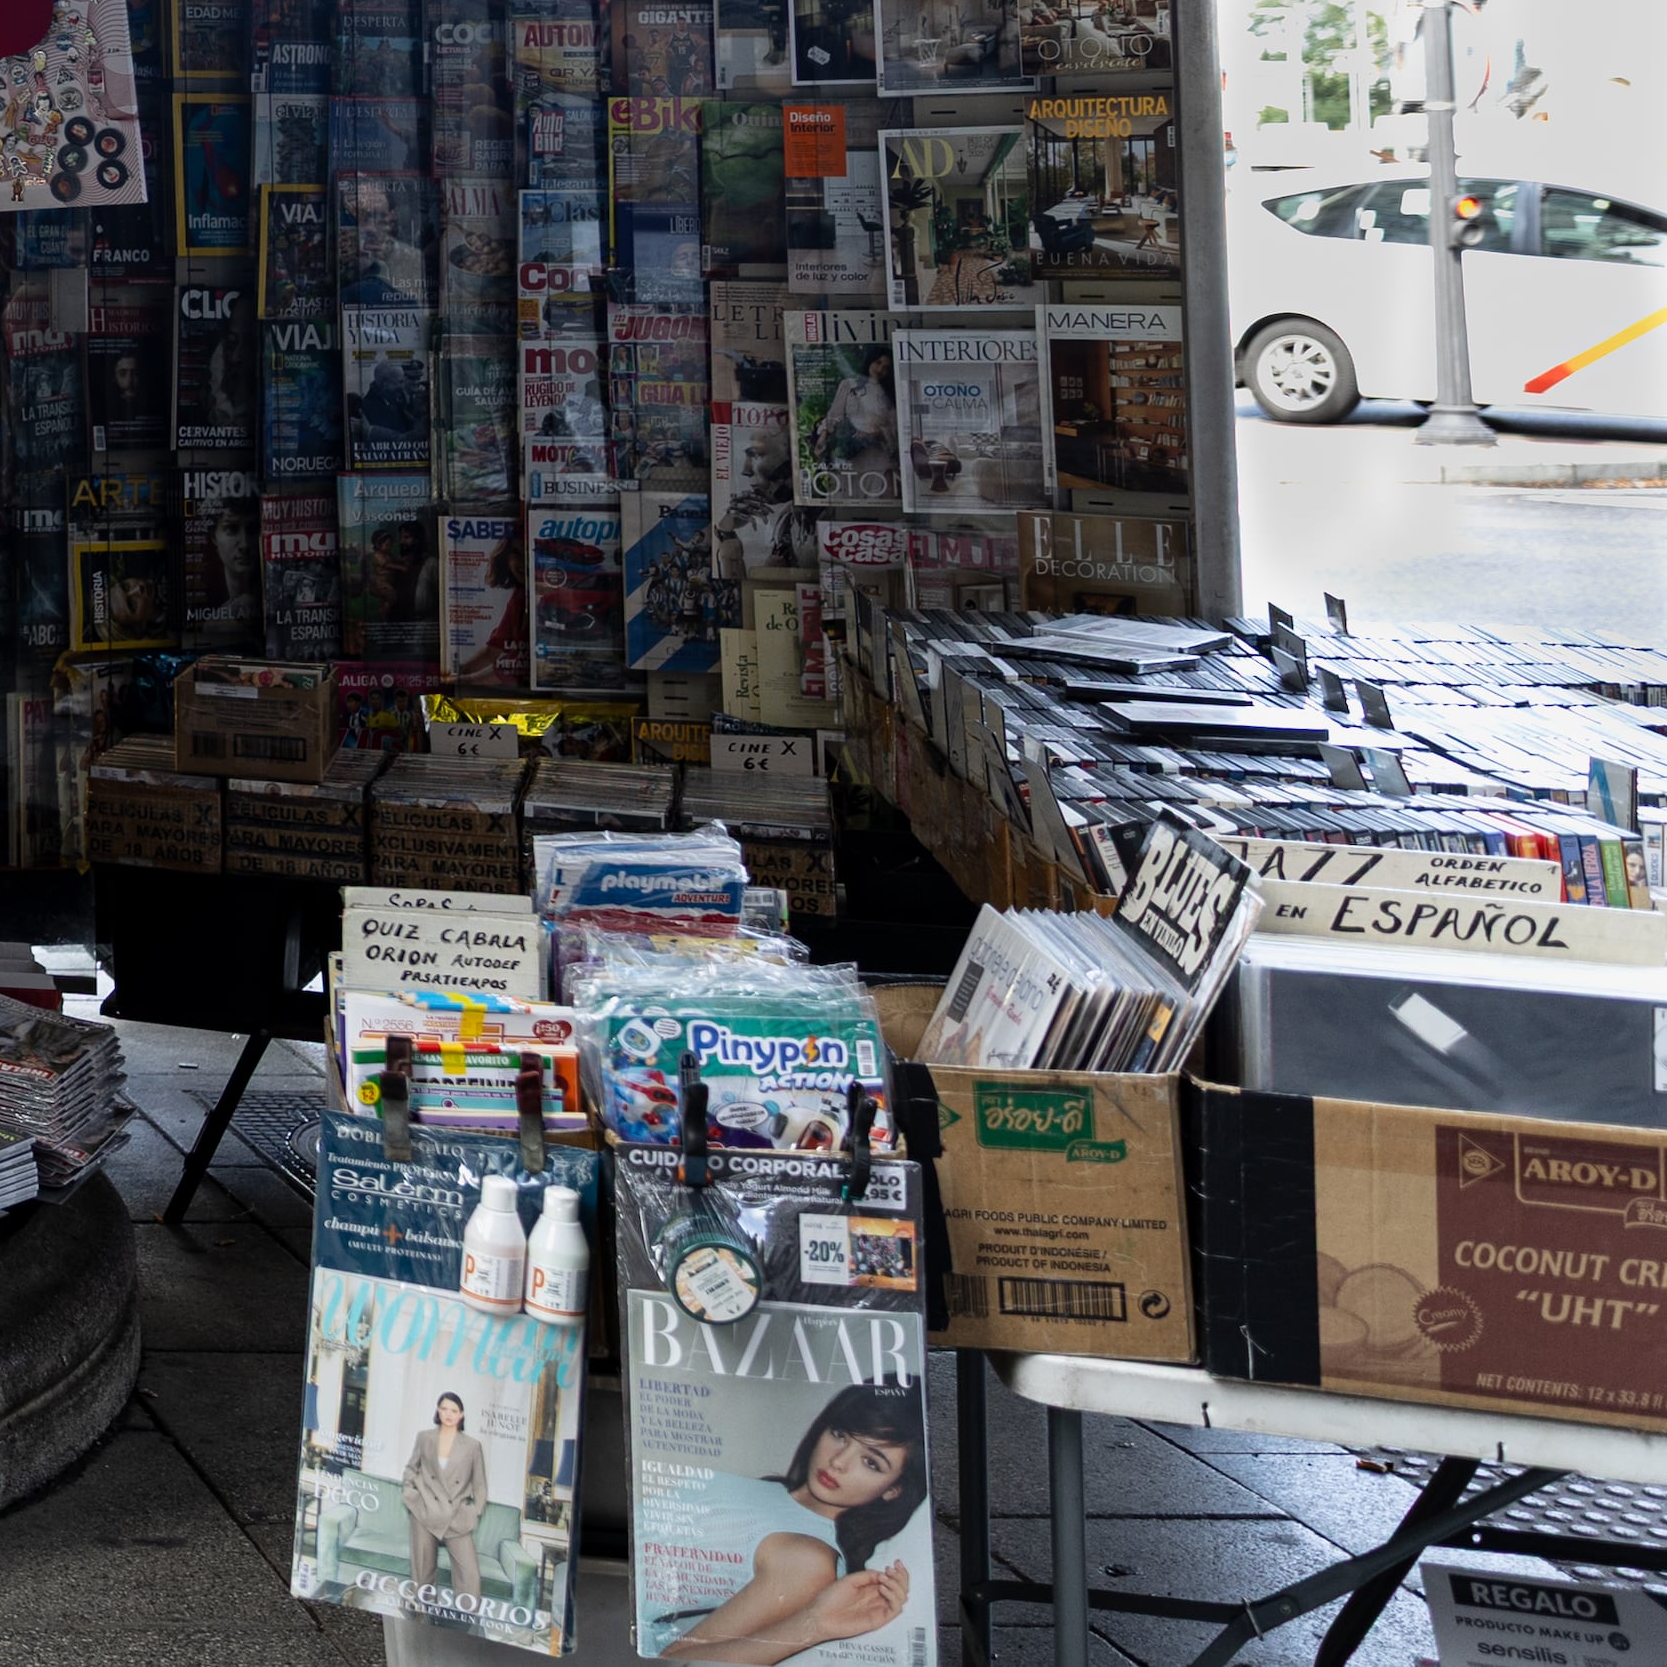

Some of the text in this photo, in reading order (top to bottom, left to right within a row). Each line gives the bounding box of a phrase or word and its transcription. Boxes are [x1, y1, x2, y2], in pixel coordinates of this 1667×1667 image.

[186, 7, 221, 19] EDAD
[344, 16, 406, 27] DESPERTA
[789, 110, 830, 124] Diseño
[1029, 96, 1167, 119] ARQUITECTURA
[790, 122, 836, 133] Interior
[1067, 117, 1131, 139] DISEÑO
[892, 138, 954, 180] AD
[93, 249, 150, 262] FRANCO
[1036, 250, 1174, 267] BUENA VIDA
[795, 262, 849, 272] Interiores
[1047, 312, 1167, 330] MANERA
[525, 383, 562, 396] RUGIDO
[924, 382, 981, 397] OTOÑO
[354, 509, 417, 522] Vascones
[1033, 516, 1175, 567] ELLE
[1035, 558, 1175, 584] DECORATION
[447, 725, 484, 739] CINE
[729, 740, 770, 756] CINE
[1430, 857, 1508, 874] ORDEN
[1415, 872, 1543, 895] ALFABETICO
[674, 892, 732, 904] ADVENTURE
[361, 917, 419, 943] QUIZ
[1275, 893, 1569, 949] EN ESPAÑOL
[366, 943, 521, 971] ORION AUTODEF
[689, 1020, 848, 1069] Pinypon
[759, 1070, 855, 1094] ACTION
[1071, 1144, 1121, 1160] AROY-D
[728, 1156, 844, 1181] CORPORAL
[1524, 1156, 1657, 1193] AROY-D
[332, 1168, 464, 1207] Salerm
[331, 1191, 463, 1219] COSMETICS
[975, 1209, 1167, 1231] FOODS PUBLIC COMPANY LIMITED
[994, 1225, 1090, 1241] www.thaiagri.com
[804, 1239, 845, 1265] -20%
[1455, 1240, 1608, 1282] COCONUT
[643, 1297, 915, 1390] BAZAAR
[639, 1377, 711, 1398] LIBERTAD
[1476, 1372, 1504, 1390] NET
[642, 1461, 715, 1481] IGUALDAD
[644, 1542, 744, 1565] FRATERNIDAD
[1469, 1581, 1598, 1619] REGALO
[1455, 1614, 1604, 1646] PRODUCTO MAKE UP
[1476, 1641, 1568, 1665] sensilis
